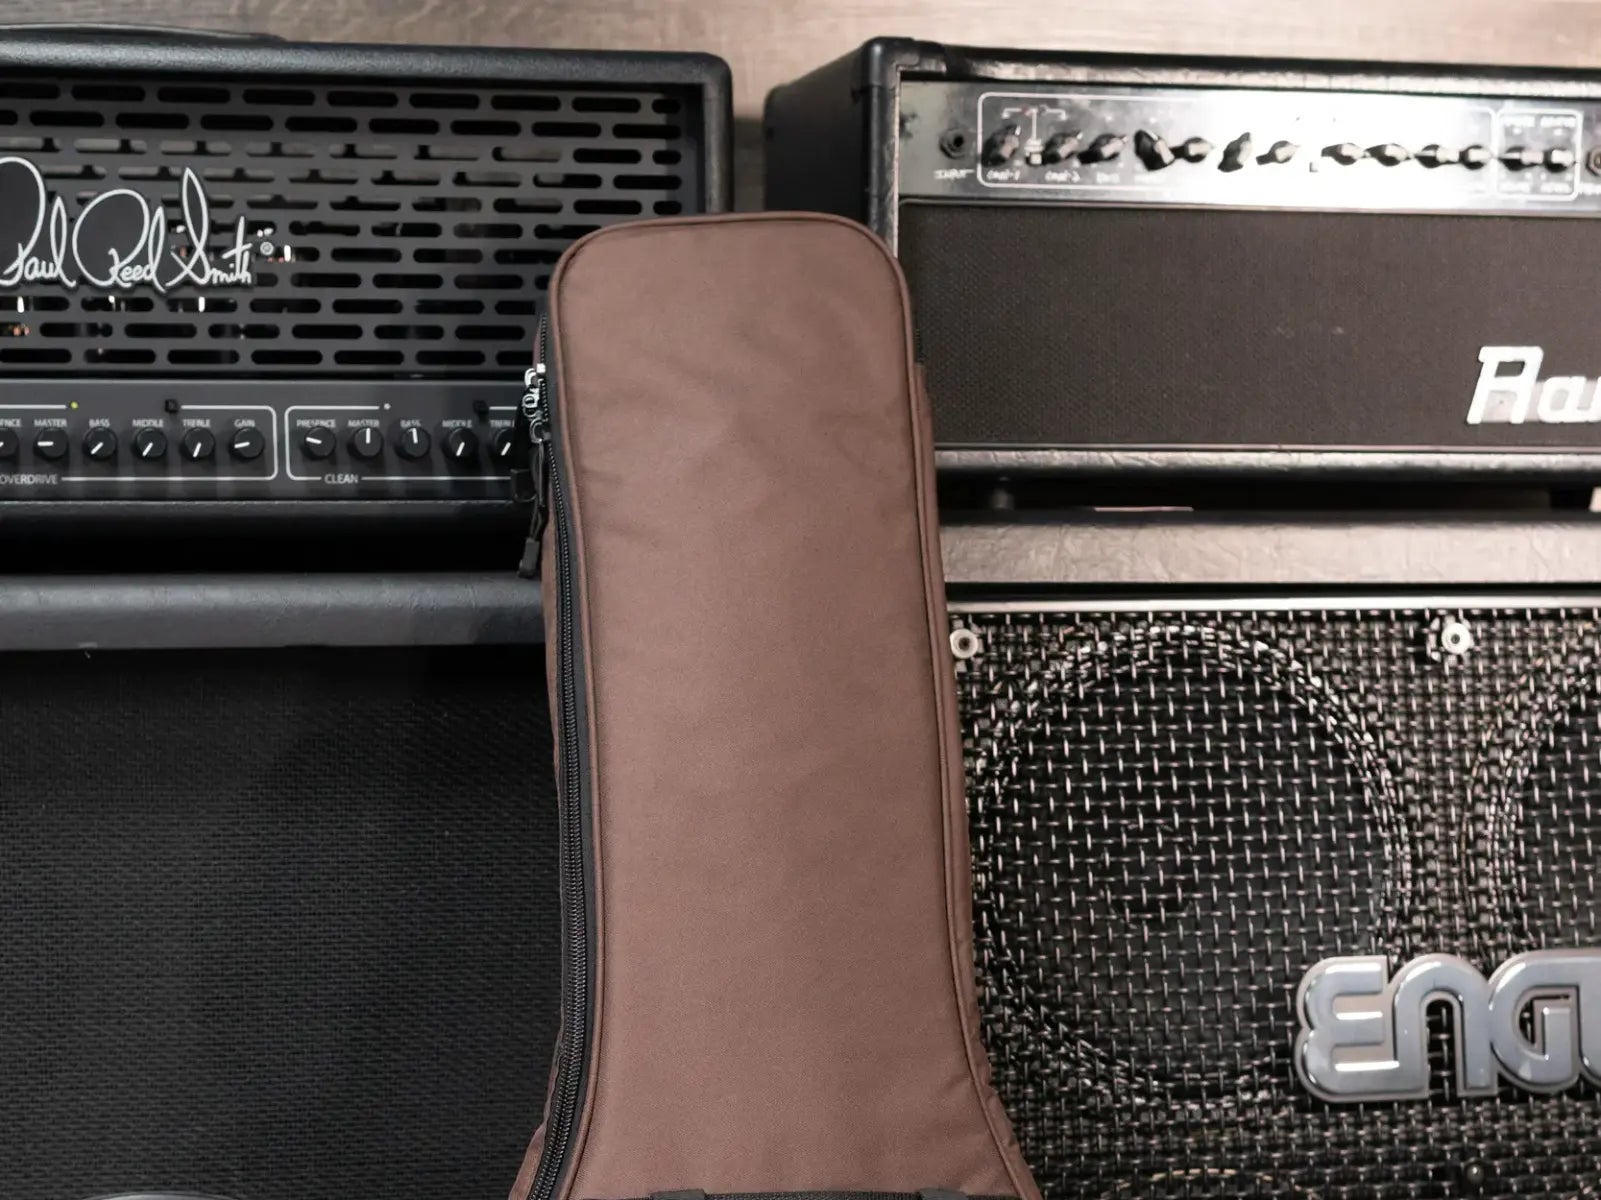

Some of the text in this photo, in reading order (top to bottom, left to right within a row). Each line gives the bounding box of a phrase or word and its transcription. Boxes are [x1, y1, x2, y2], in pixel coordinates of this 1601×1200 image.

[1467, 345, 1601, 424] Ra
[34, 418, 67, 428] MASTER
[325, 474, 358, 484] CLEAN
